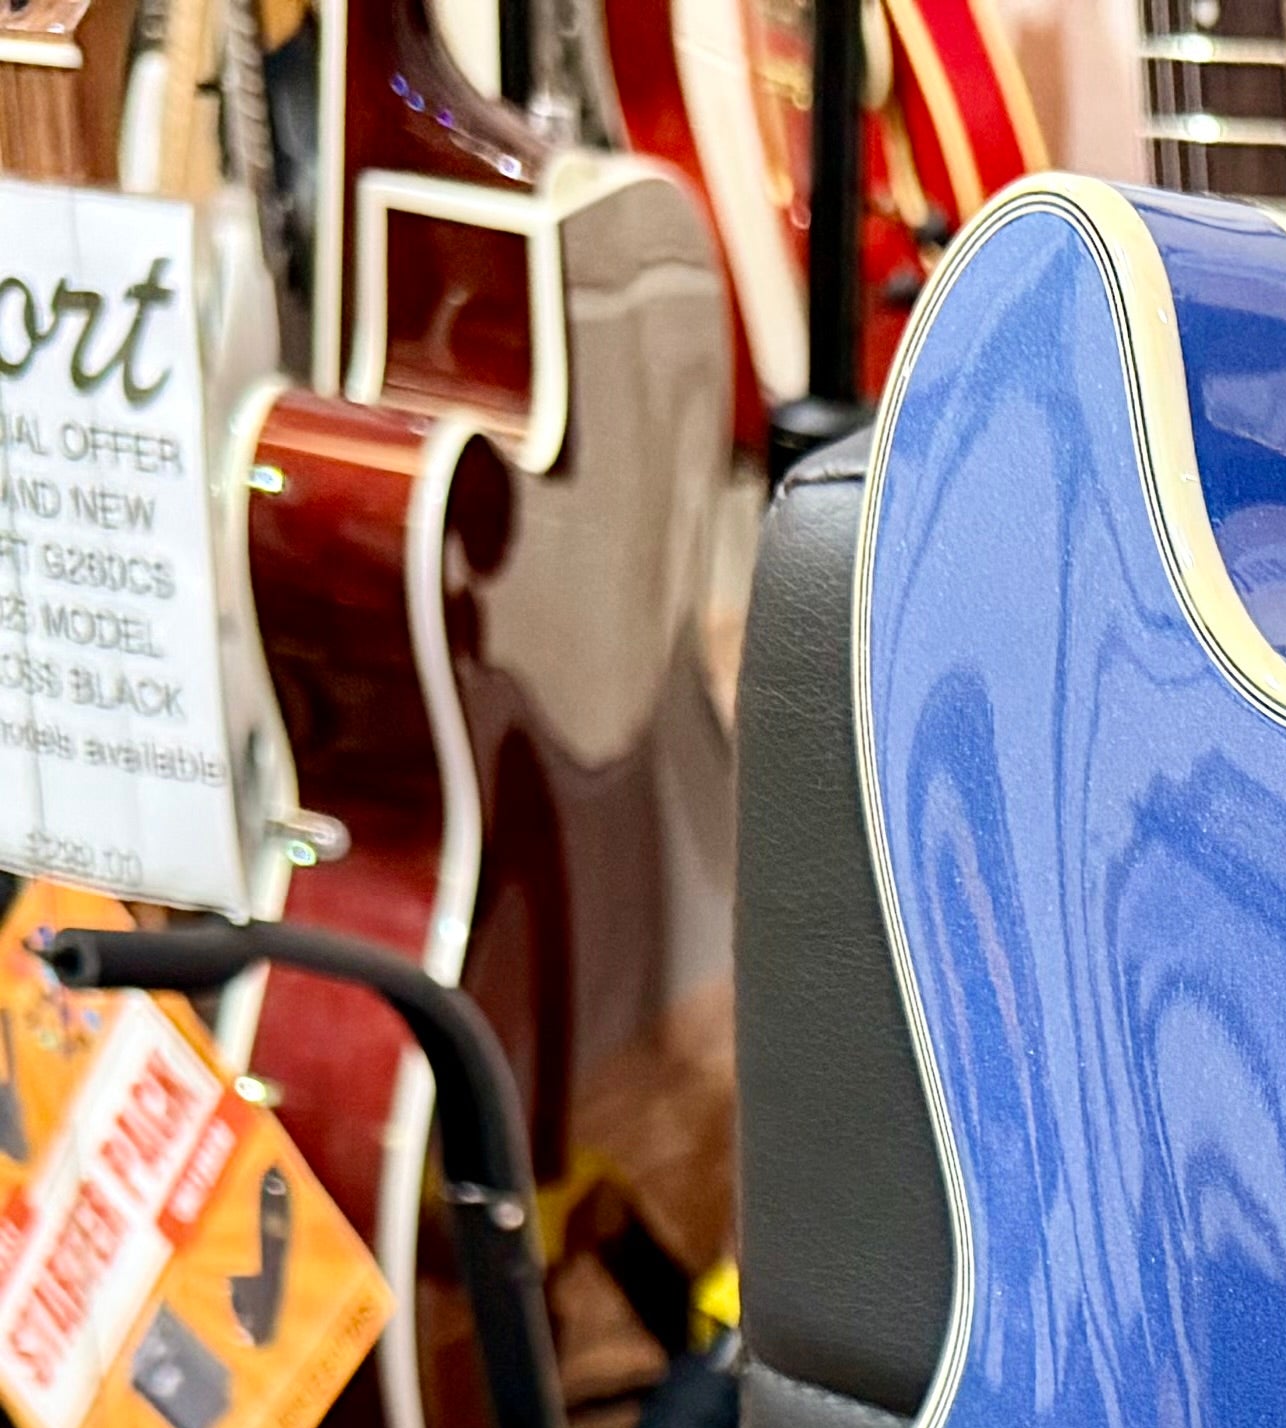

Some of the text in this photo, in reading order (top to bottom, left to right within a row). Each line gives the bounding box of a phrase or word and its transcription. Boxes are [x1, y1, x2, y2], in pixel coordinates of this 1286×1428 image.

[61, 421, 183, 475] OFFER
[69, 486, 156, 533] NEW
[41, 601, 165, 659] MODEL
[68, 666, 186, 720] BLACK
[82, 737, 227, 788] available
[8, 1178, 132, 1388] STARTER
[98, 1048, 204, 1204] PACK
